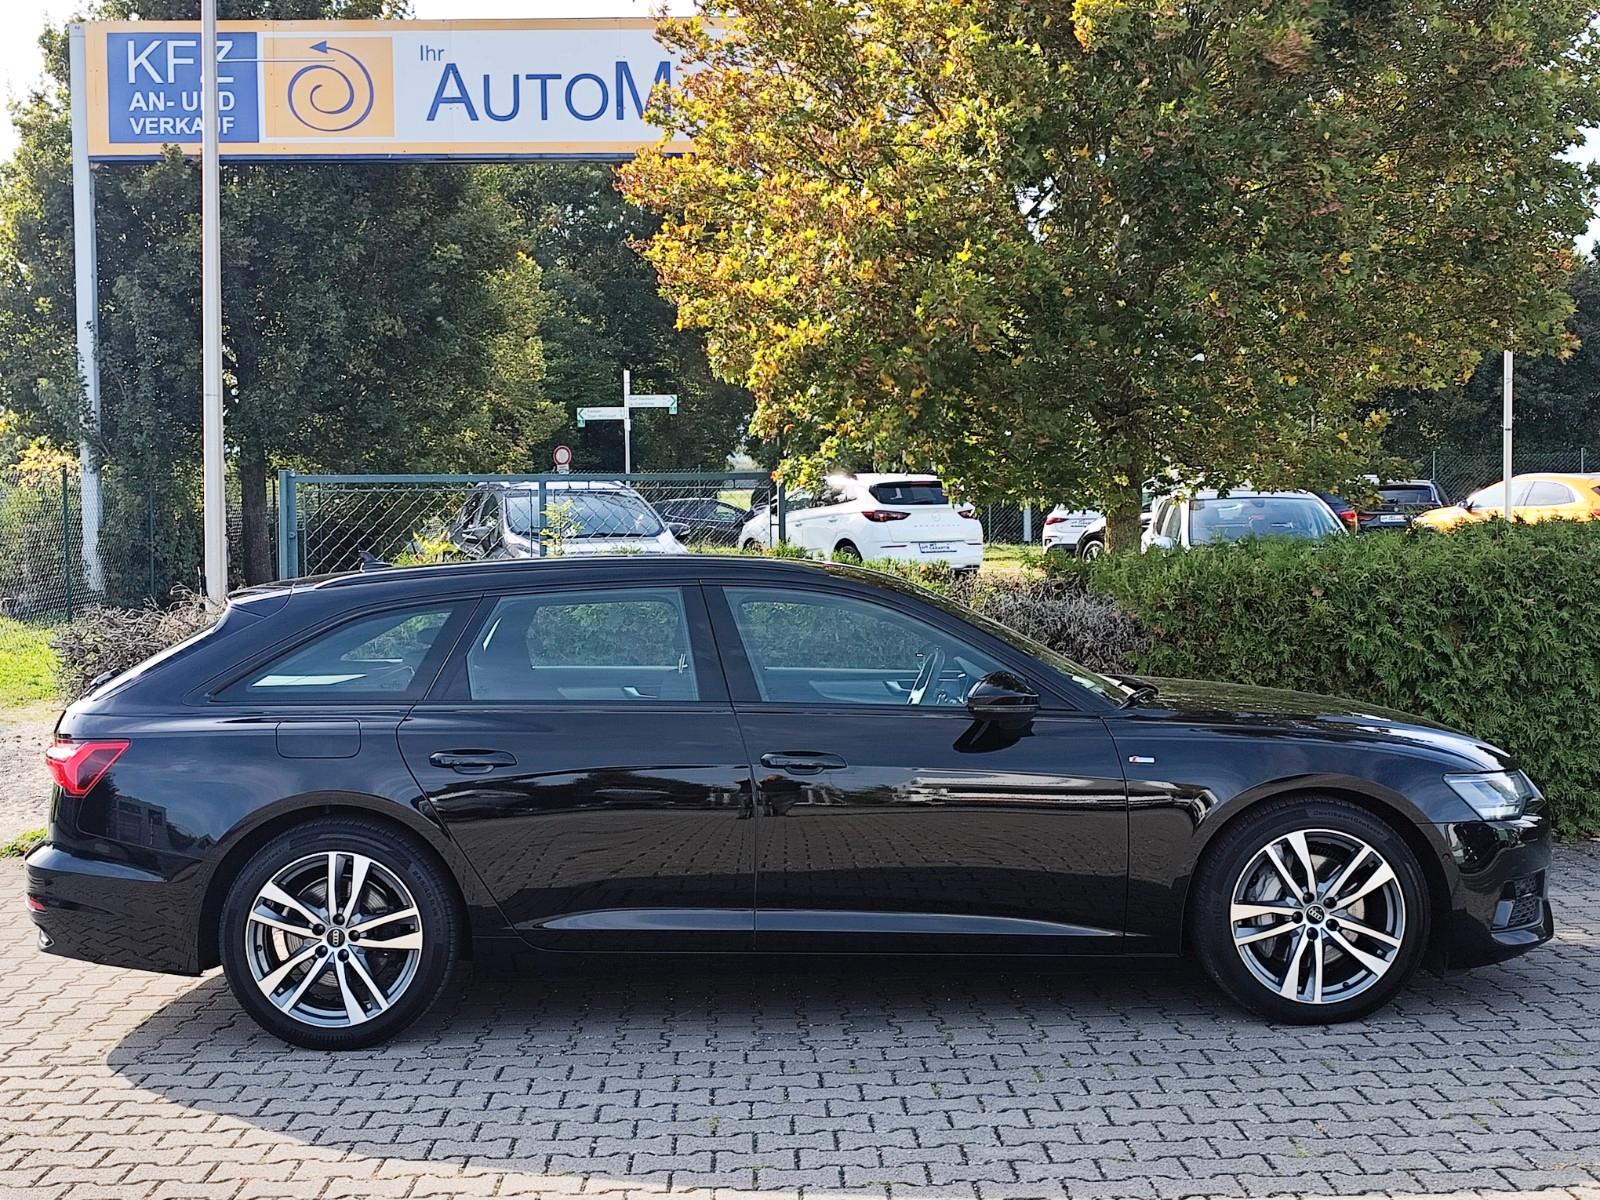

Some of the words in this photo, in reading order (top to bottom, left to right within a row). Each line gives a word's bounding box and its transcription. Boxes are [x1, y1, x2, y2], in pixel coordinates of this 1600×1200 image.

[419, 44, 445, 62] Ihr
[425, 60, 690, 122] AUTOM
[128, 91, 176, 111] AN-
[181, 91, 235, 112] UD
[129, 116, 234, 135] VERKAF
